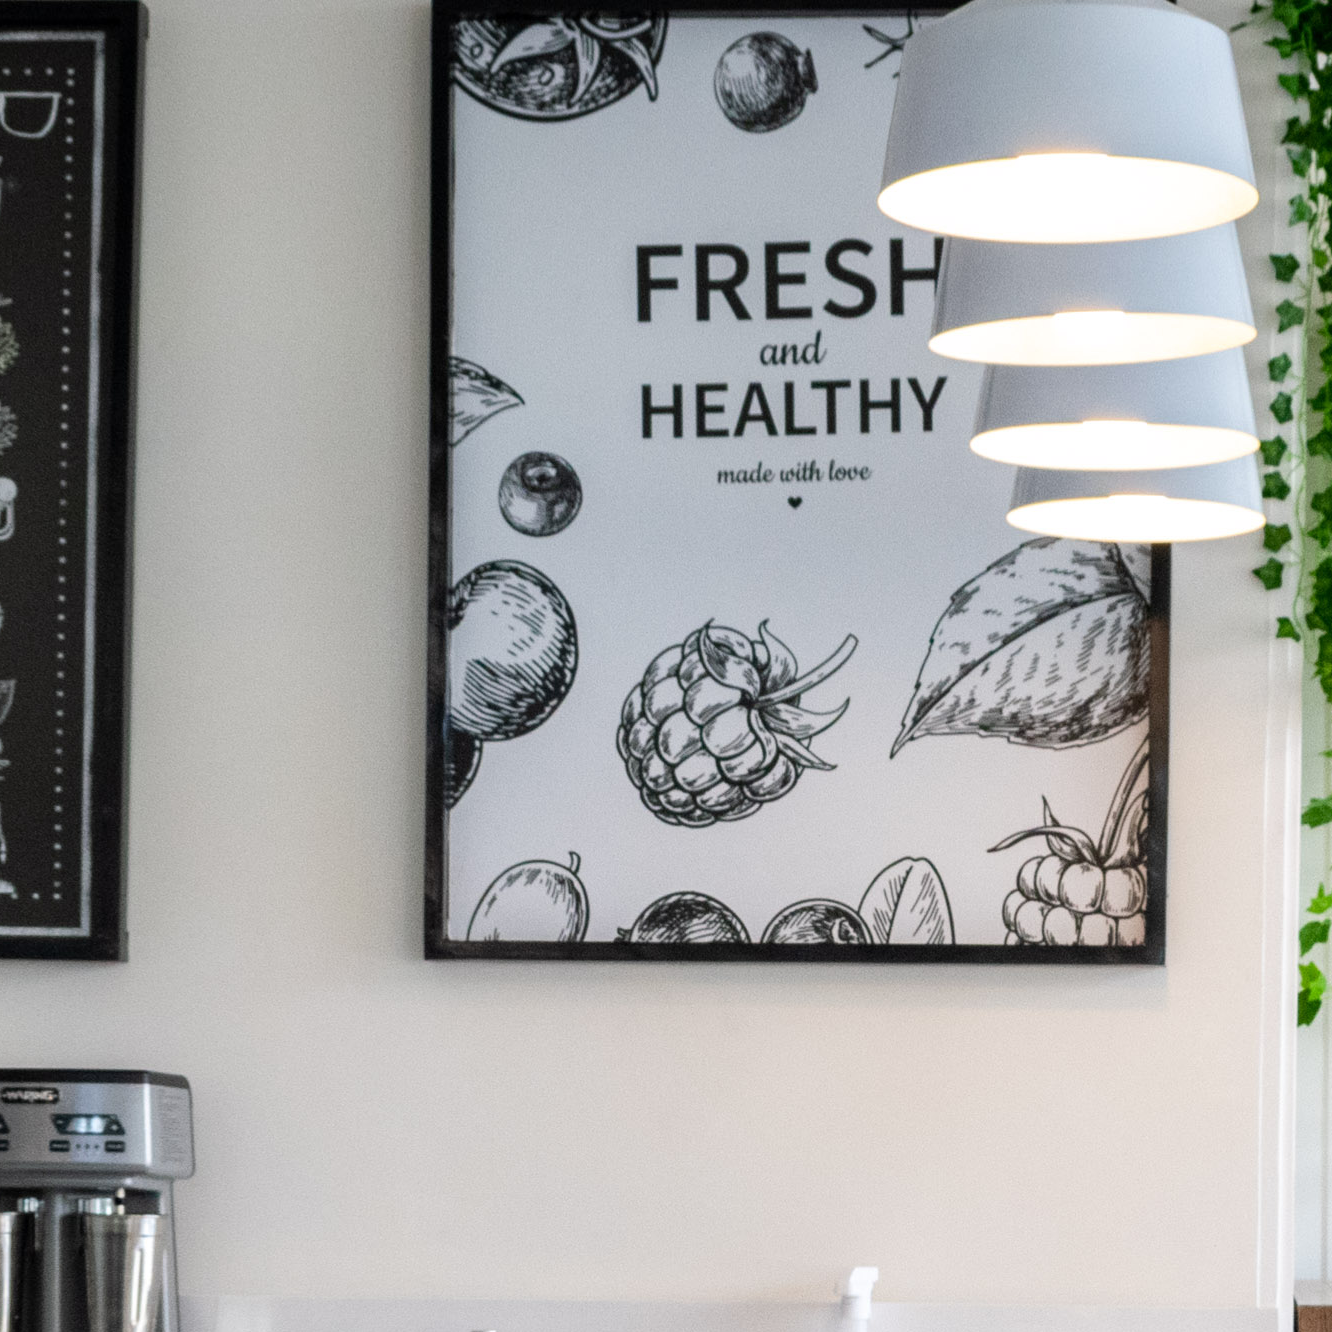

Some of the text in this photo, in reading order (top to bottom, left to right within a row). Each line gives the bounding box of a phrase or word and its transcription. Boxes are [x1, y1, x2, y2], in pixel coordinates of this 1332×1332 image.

[636, 236, 945, 323] FRESH
[759, 329, 827, 366] and
[641, 375, 948, 439] HEALTHY
[717, 458, 873, 484] made with love
